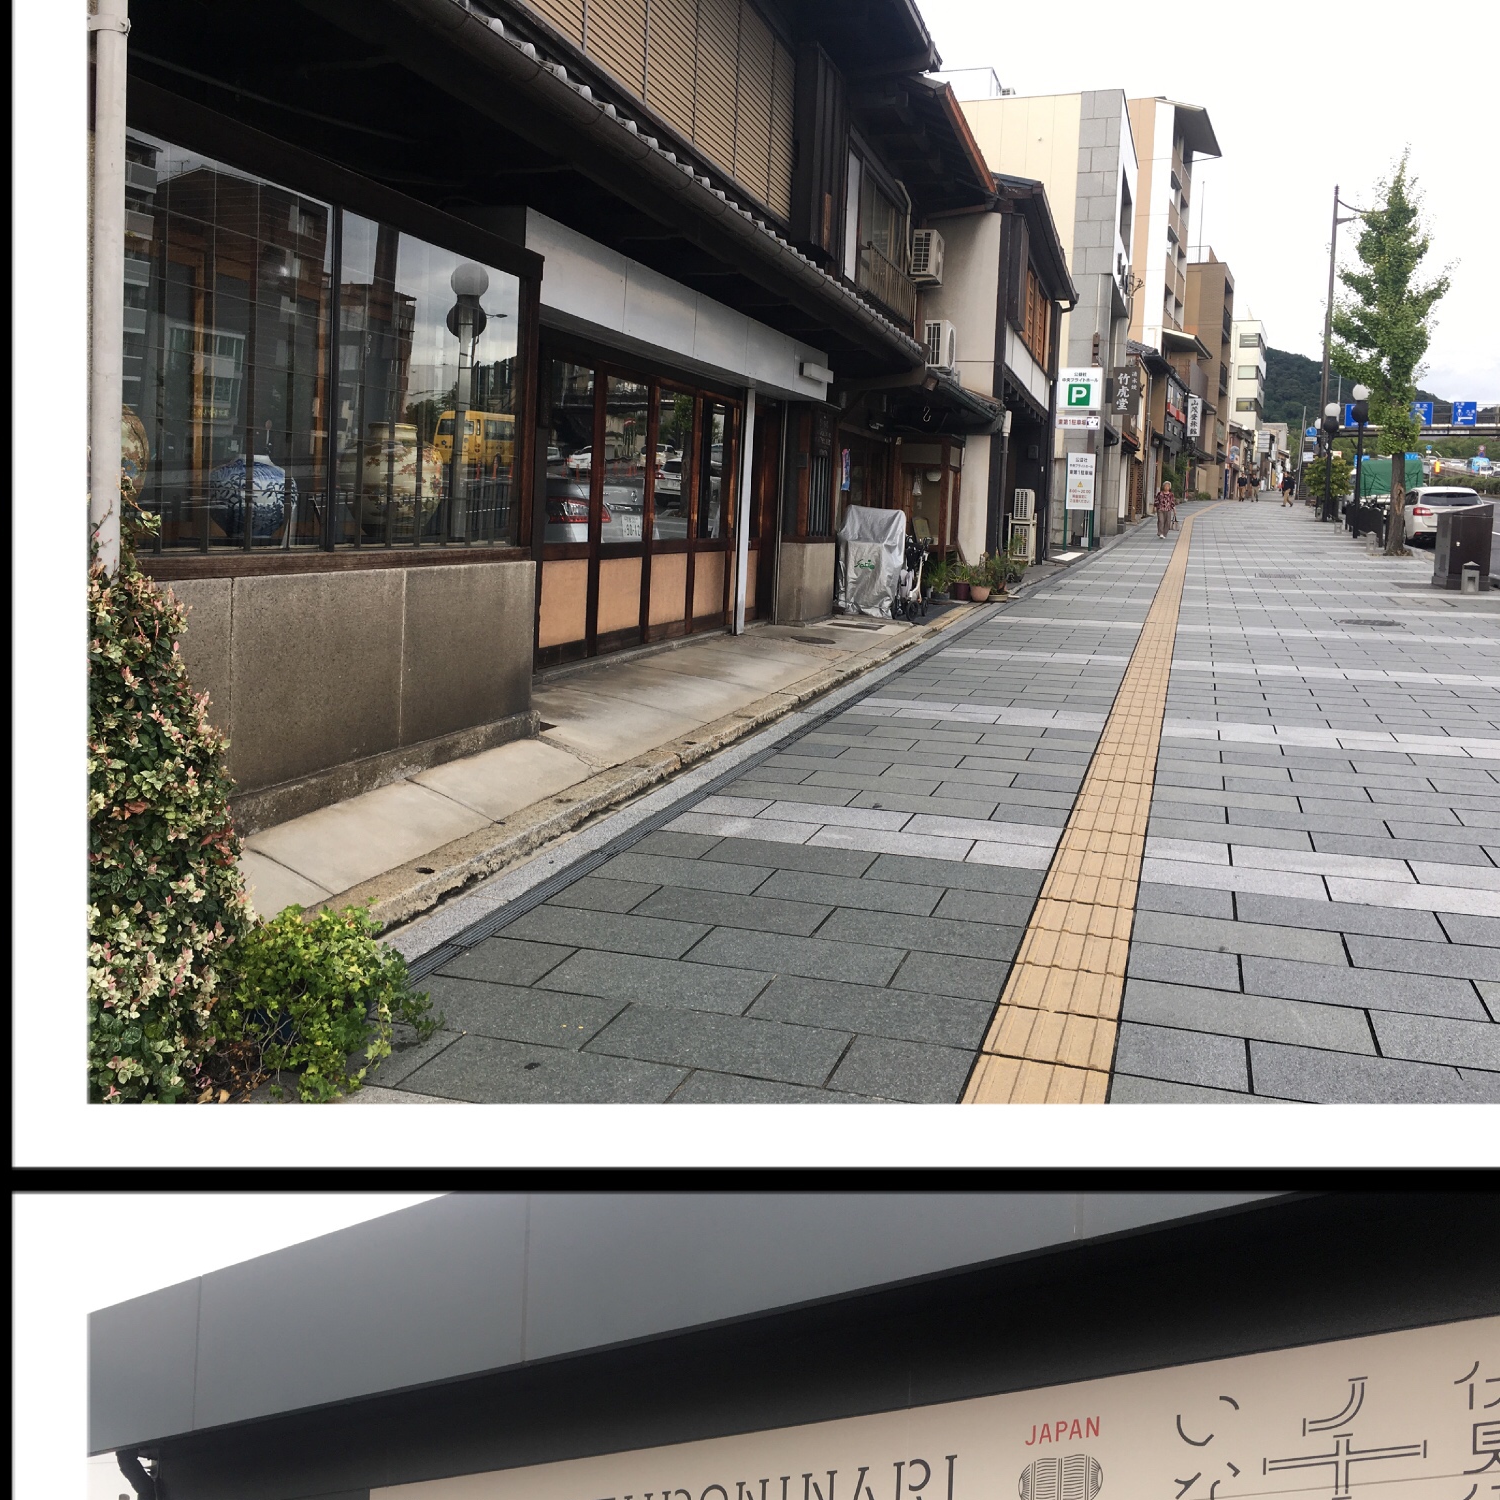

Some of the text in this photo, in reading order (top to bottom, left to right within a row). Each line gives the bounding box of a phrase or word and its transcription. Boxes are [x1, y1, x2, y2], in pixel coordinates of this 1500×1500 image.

[1071, 386, 1088, 404] P
[1115, 373, 1131, 411] 竹虎堂
[1025, 1416, 1100, 1446] JAPAN
